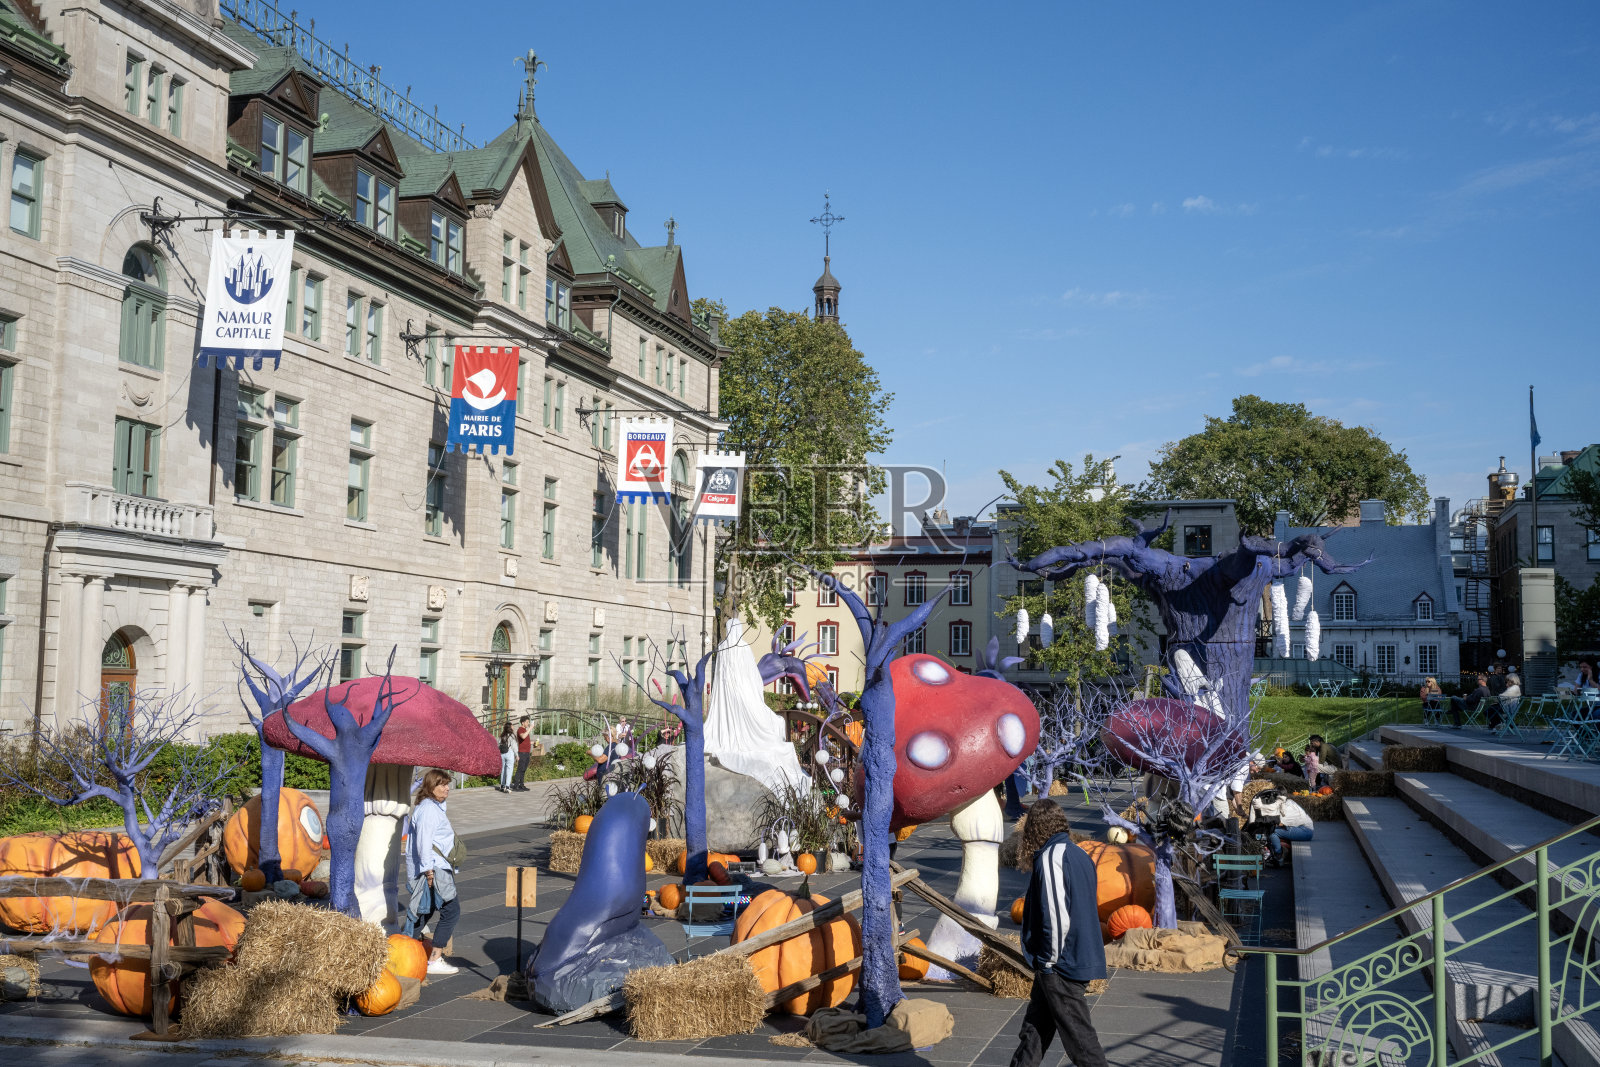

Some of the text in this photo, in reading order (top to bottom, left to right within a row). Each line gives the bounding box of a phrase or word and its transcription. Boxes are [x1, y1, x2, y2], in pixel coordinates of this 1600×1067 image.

[217, 310, 272, 324] NAMUR
[216, 326, 272, 340] CAPITALE
[459, 423, 502, 437] PARIS
[628, 433, 665, 441] BORDEAUX
[707, 495, 729, 503] Calgary
